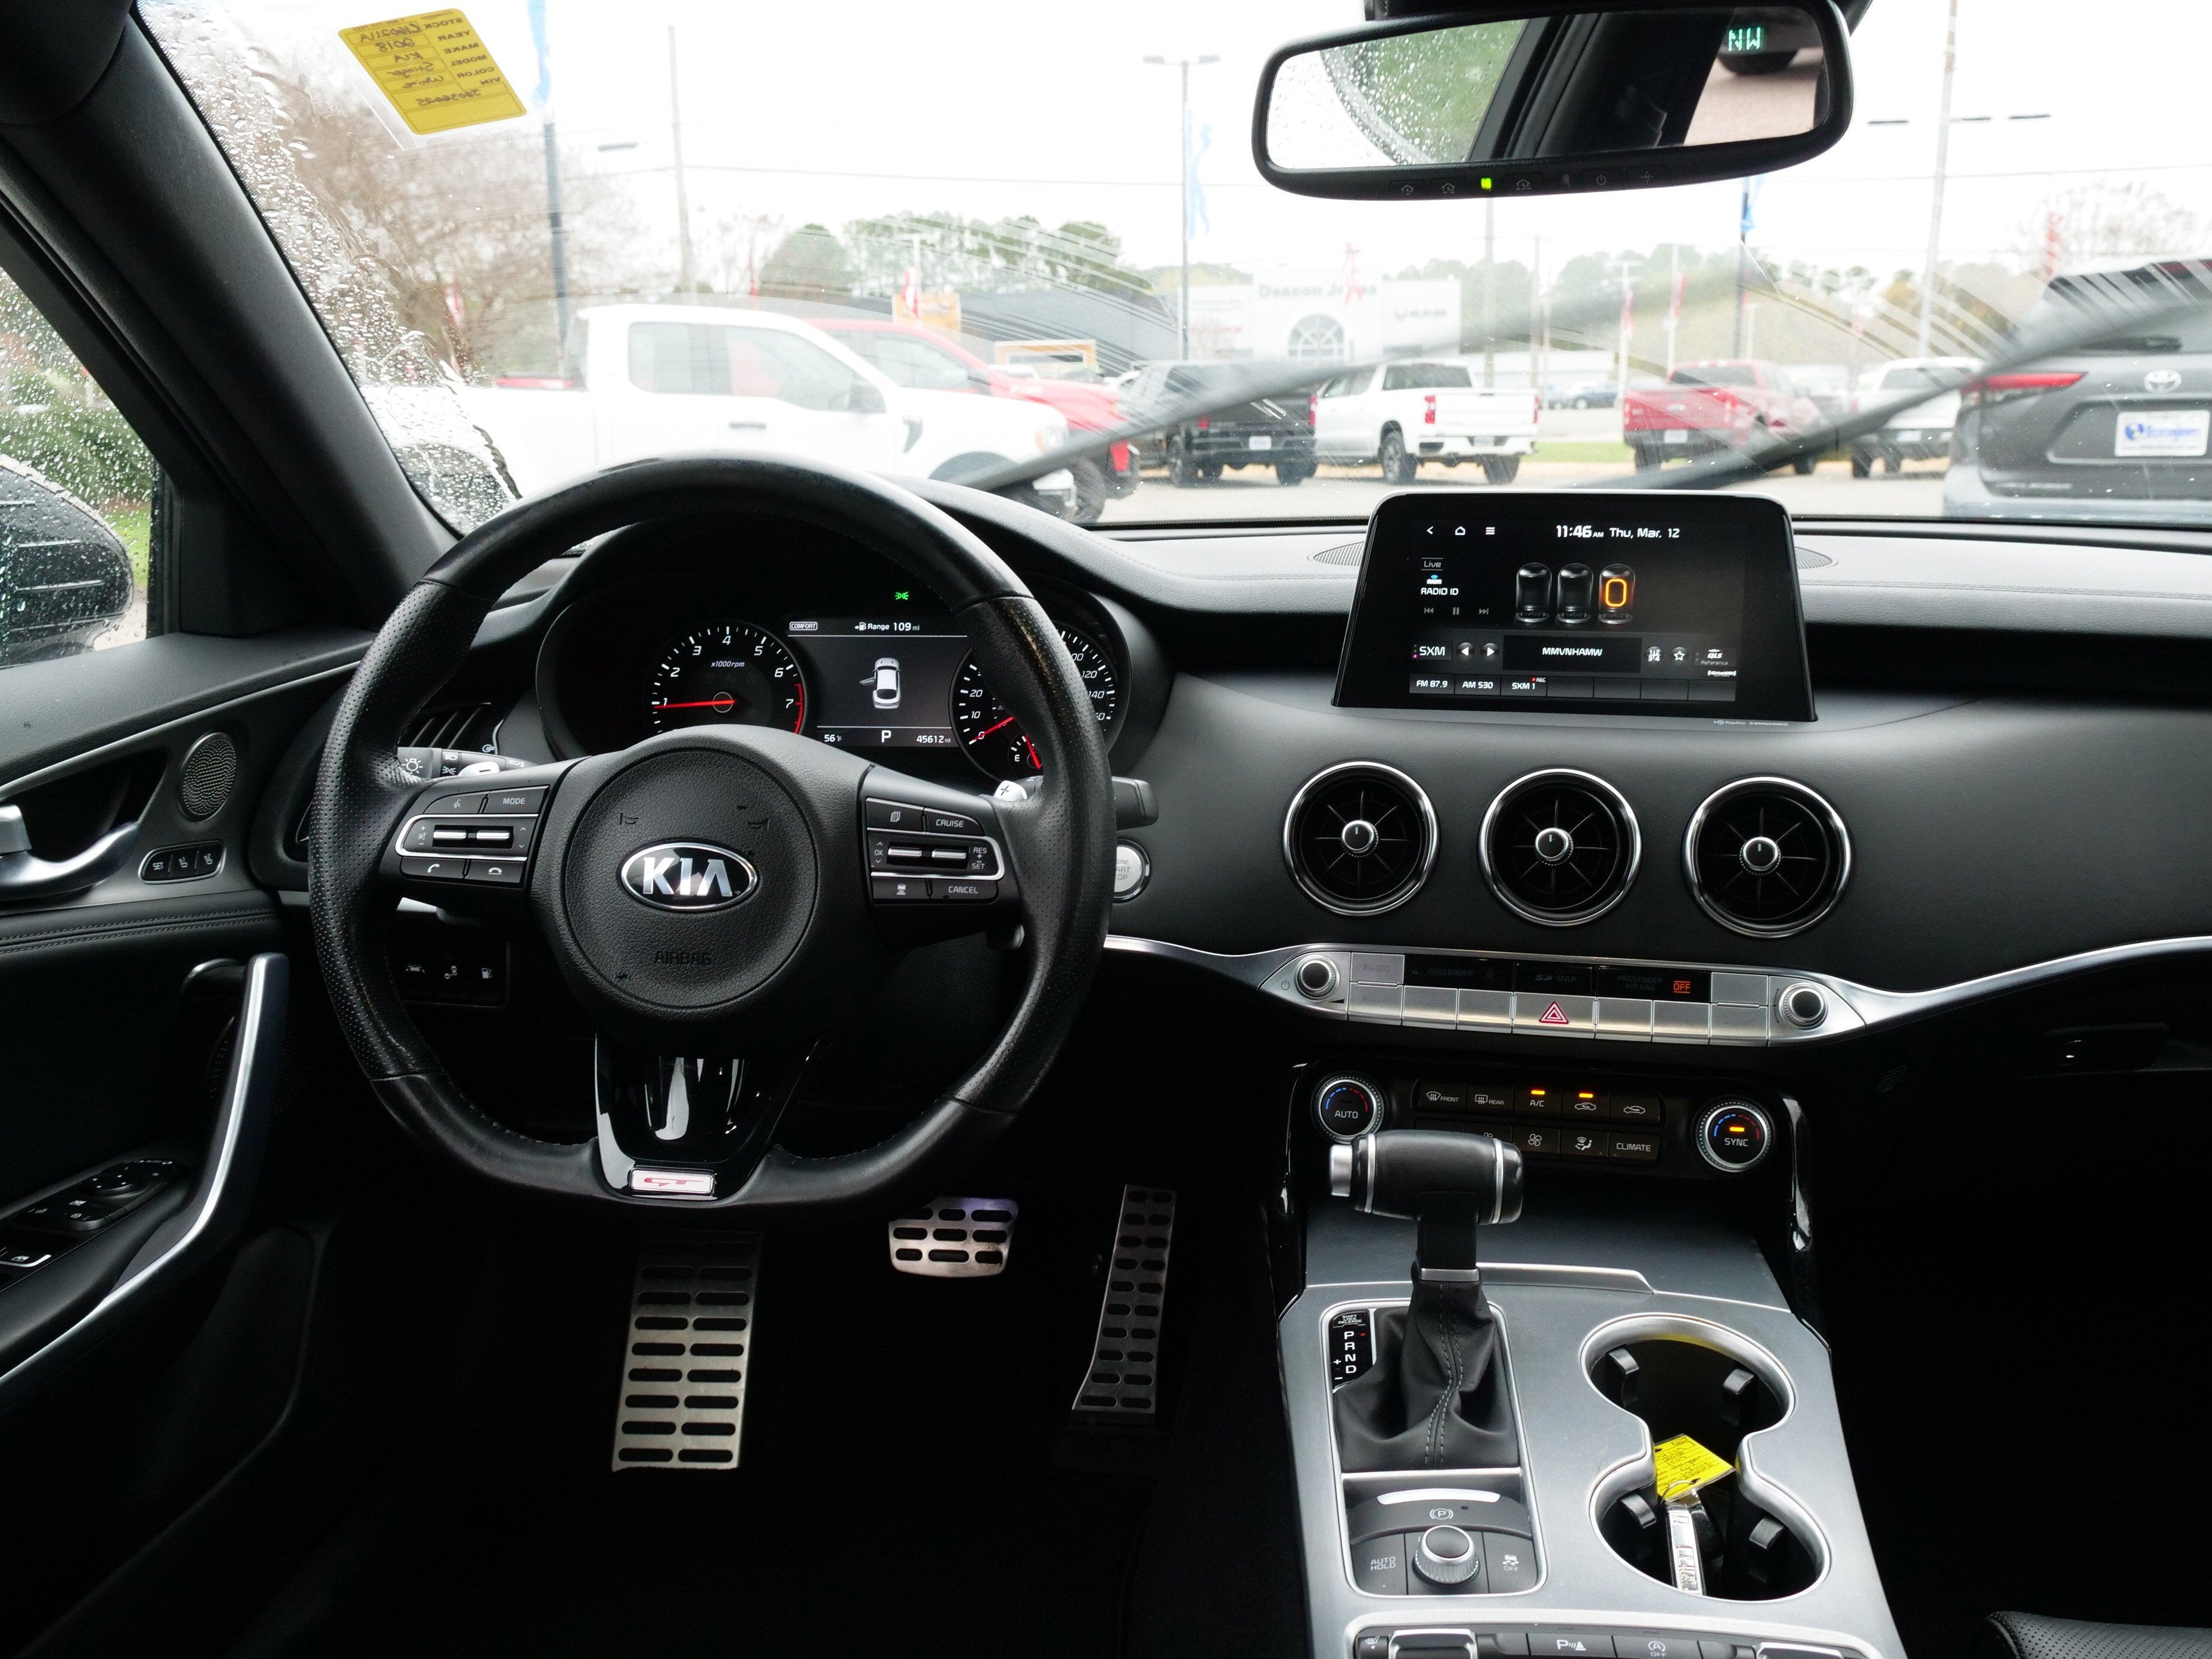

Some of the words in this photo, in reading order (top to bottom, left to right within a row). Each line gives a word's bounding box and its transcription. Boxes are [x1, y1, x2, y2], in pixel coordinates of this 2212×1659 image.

[1728, 27, 1761, 52] NW
[1557, 525, 1592, 538] 11:46
[1609, 527, 1634, 539] Thu,
[1668, 529, 1680, 538] 12
[1424, 560, 1441, 568] Live
[1421, 588, 1447, 596] RADIO
[1450, 588, 1459, 596] ID
[893, 622, 912, 631] 109
[722, 636, 731, 645] 4
[692, 646, 701, 655] 3
[754, 646, 763, 655] 5
[1419, 646, 1446, 656] SXM
[1071, 653, 1083, 661] 00
[670, 667, 680, 677] 2
[775, 668, 784, 678] 6
[1082, 670, 1098, 679] 120
[663, 698, 667, 707] 1
[786, 699, 794, 709] 7
[881, 731, 891, 743] P
[978, 731, 985, 740] 0
[502, 797, 526, 806] MODE
[936, 819, 964, 828] CRUISE
[643, 856, 733, 897] KIA
[1363, 964, 1390, 973] RADIO
[1428, 968, 1473, 977] PASSENGER
[1617, 975, 1663, 983] PASSENGER
[1673, 983, 1691, 992] OFF
[1335, 1110, 1358, 1119] AUTO
[1616, 1143, 1651, 1151] CLIMATE
[1725, 1138, 1748, 1147] SYNC
[1344, 1331, 1354, 1340] P
[1345, 1342, 1355, 1350] R
[1346, 1365, 1357, 1374] D
[1371, 1562, 1396, 1571] HOLD
